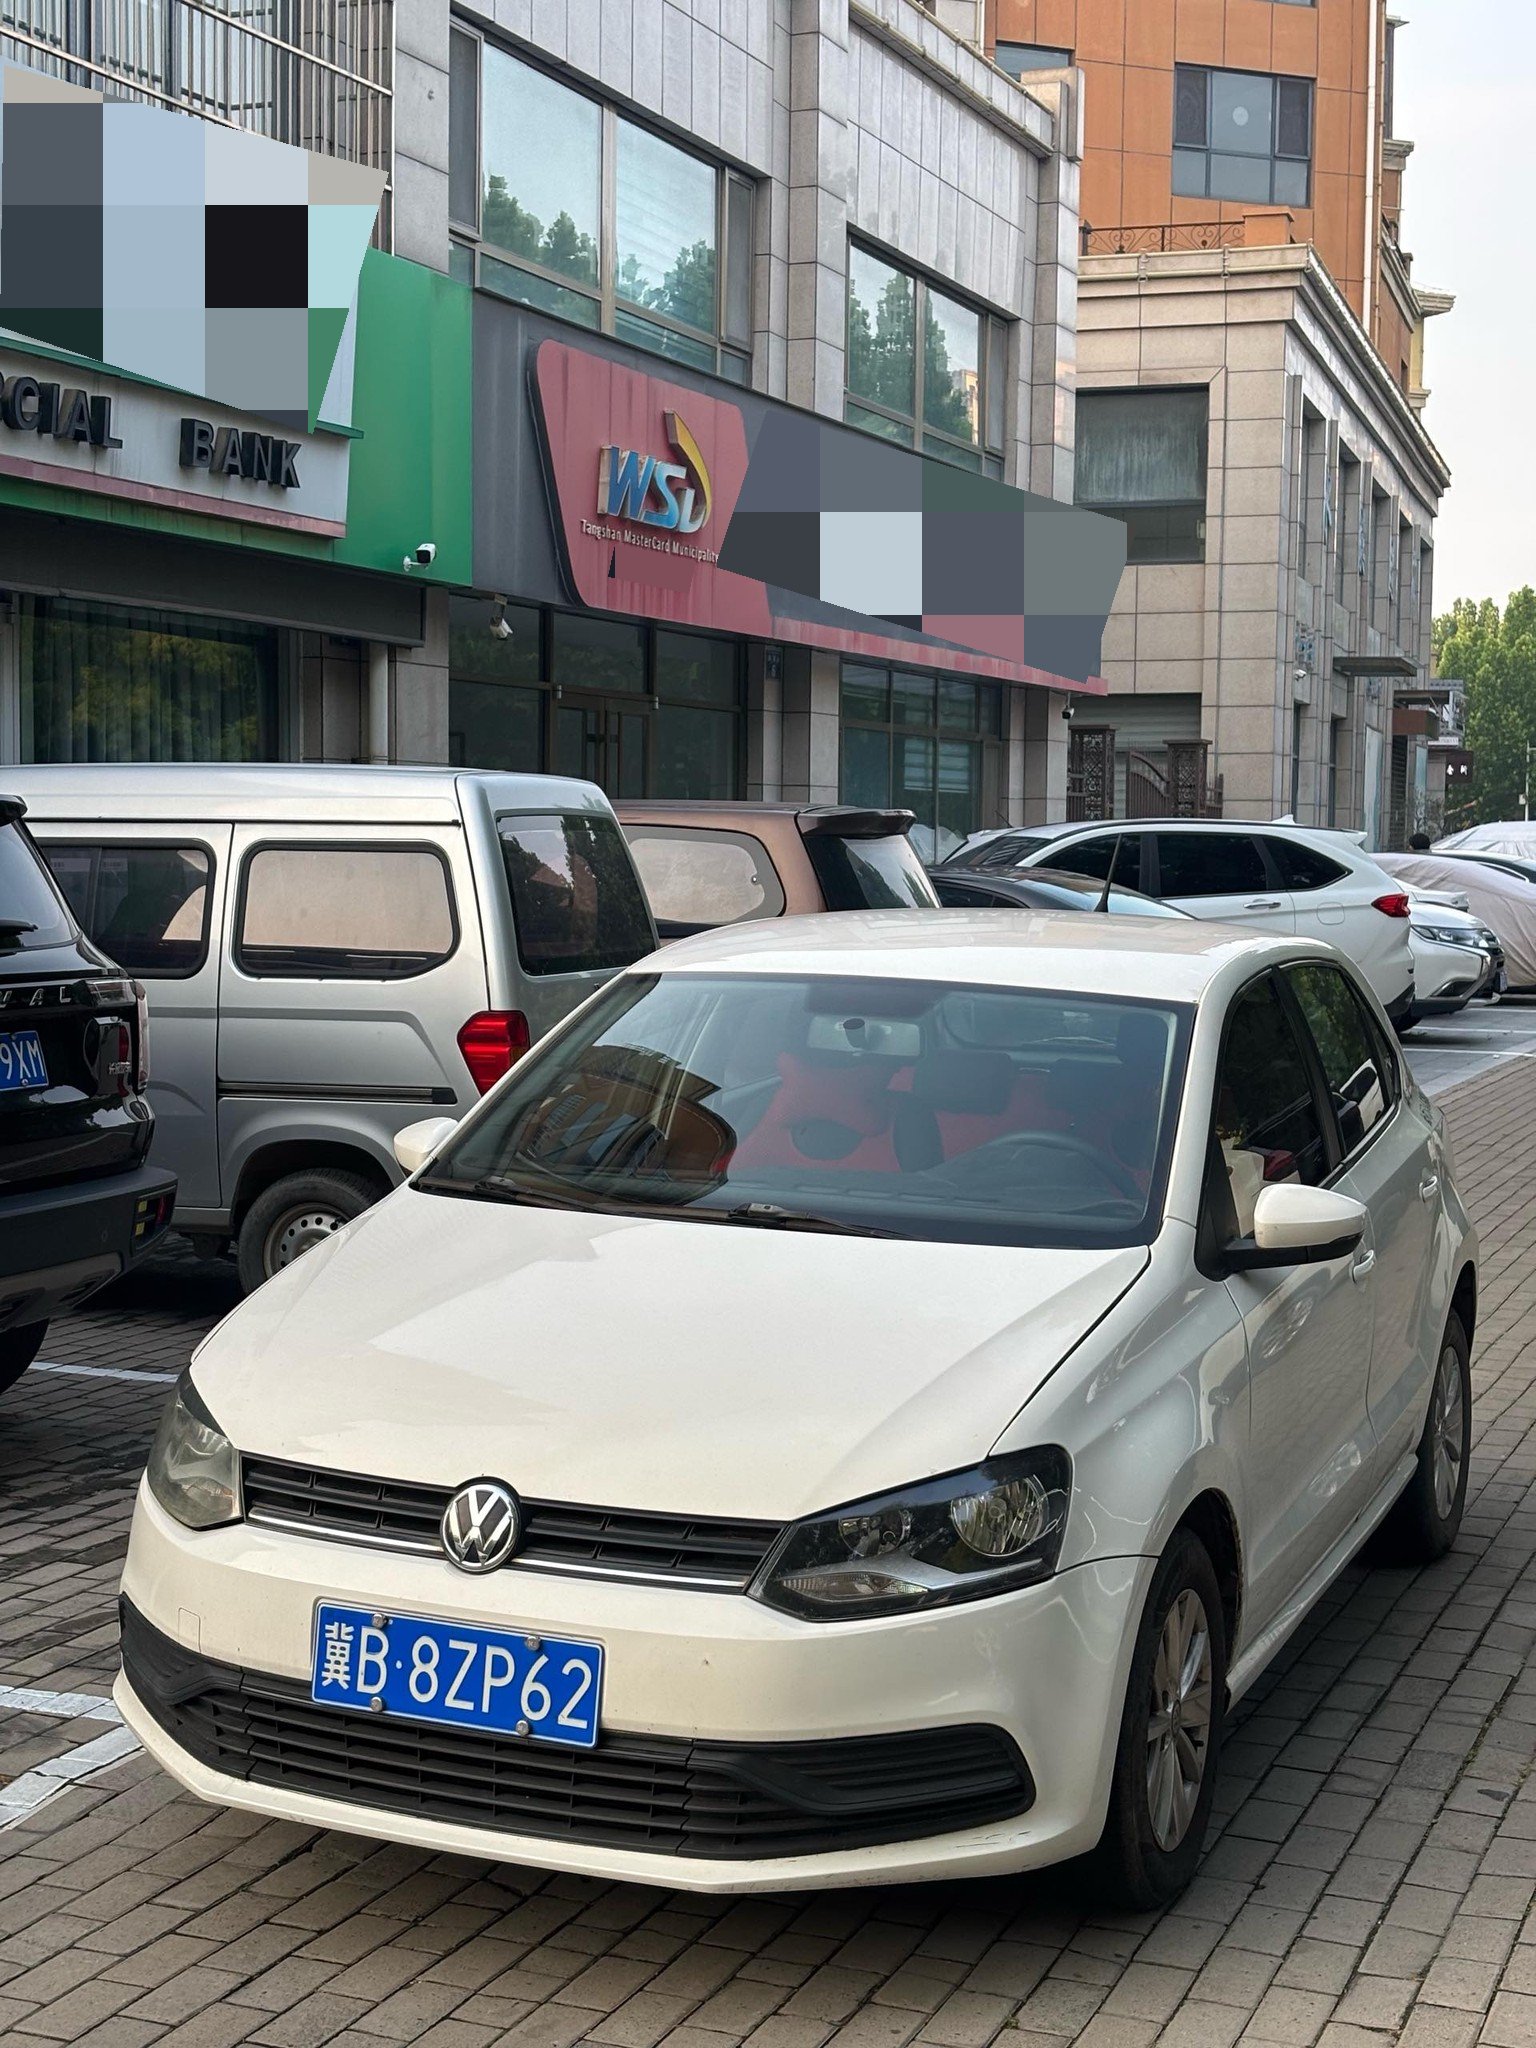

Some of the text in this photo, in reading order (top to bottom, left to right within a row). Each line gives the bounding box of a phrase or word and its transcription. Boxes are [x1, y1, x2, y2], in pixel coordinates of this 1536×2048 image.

[0, 371, 302, 488] CIAL BANK
[580, 519, 622, 541] Tangshan
[624, 529, 671, 553] MasterCard
[0, 1040, 45, 1080] 9XM
